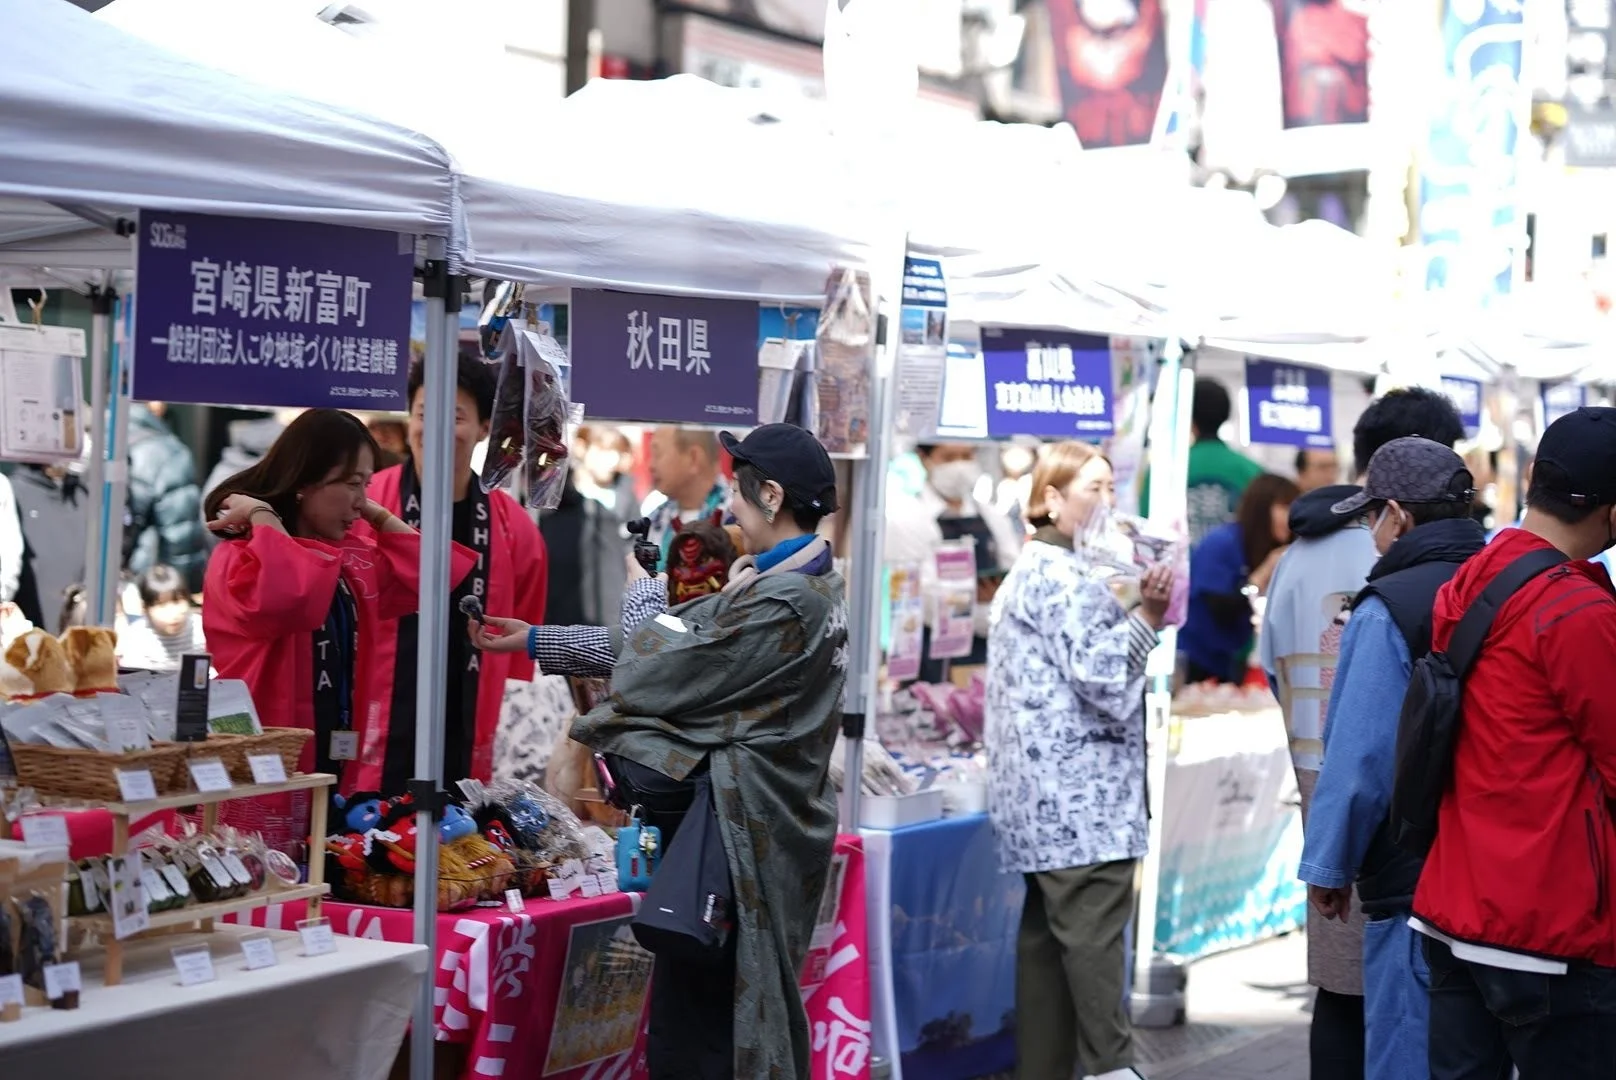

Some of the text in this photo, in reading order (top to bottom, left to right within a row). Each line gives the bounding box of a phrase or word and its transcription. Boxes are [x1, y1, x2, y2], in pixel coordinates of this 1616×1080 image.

[191, 257, 372, 328] 宮崎県新富町
[626, 310, 712, 376] 秋田県
